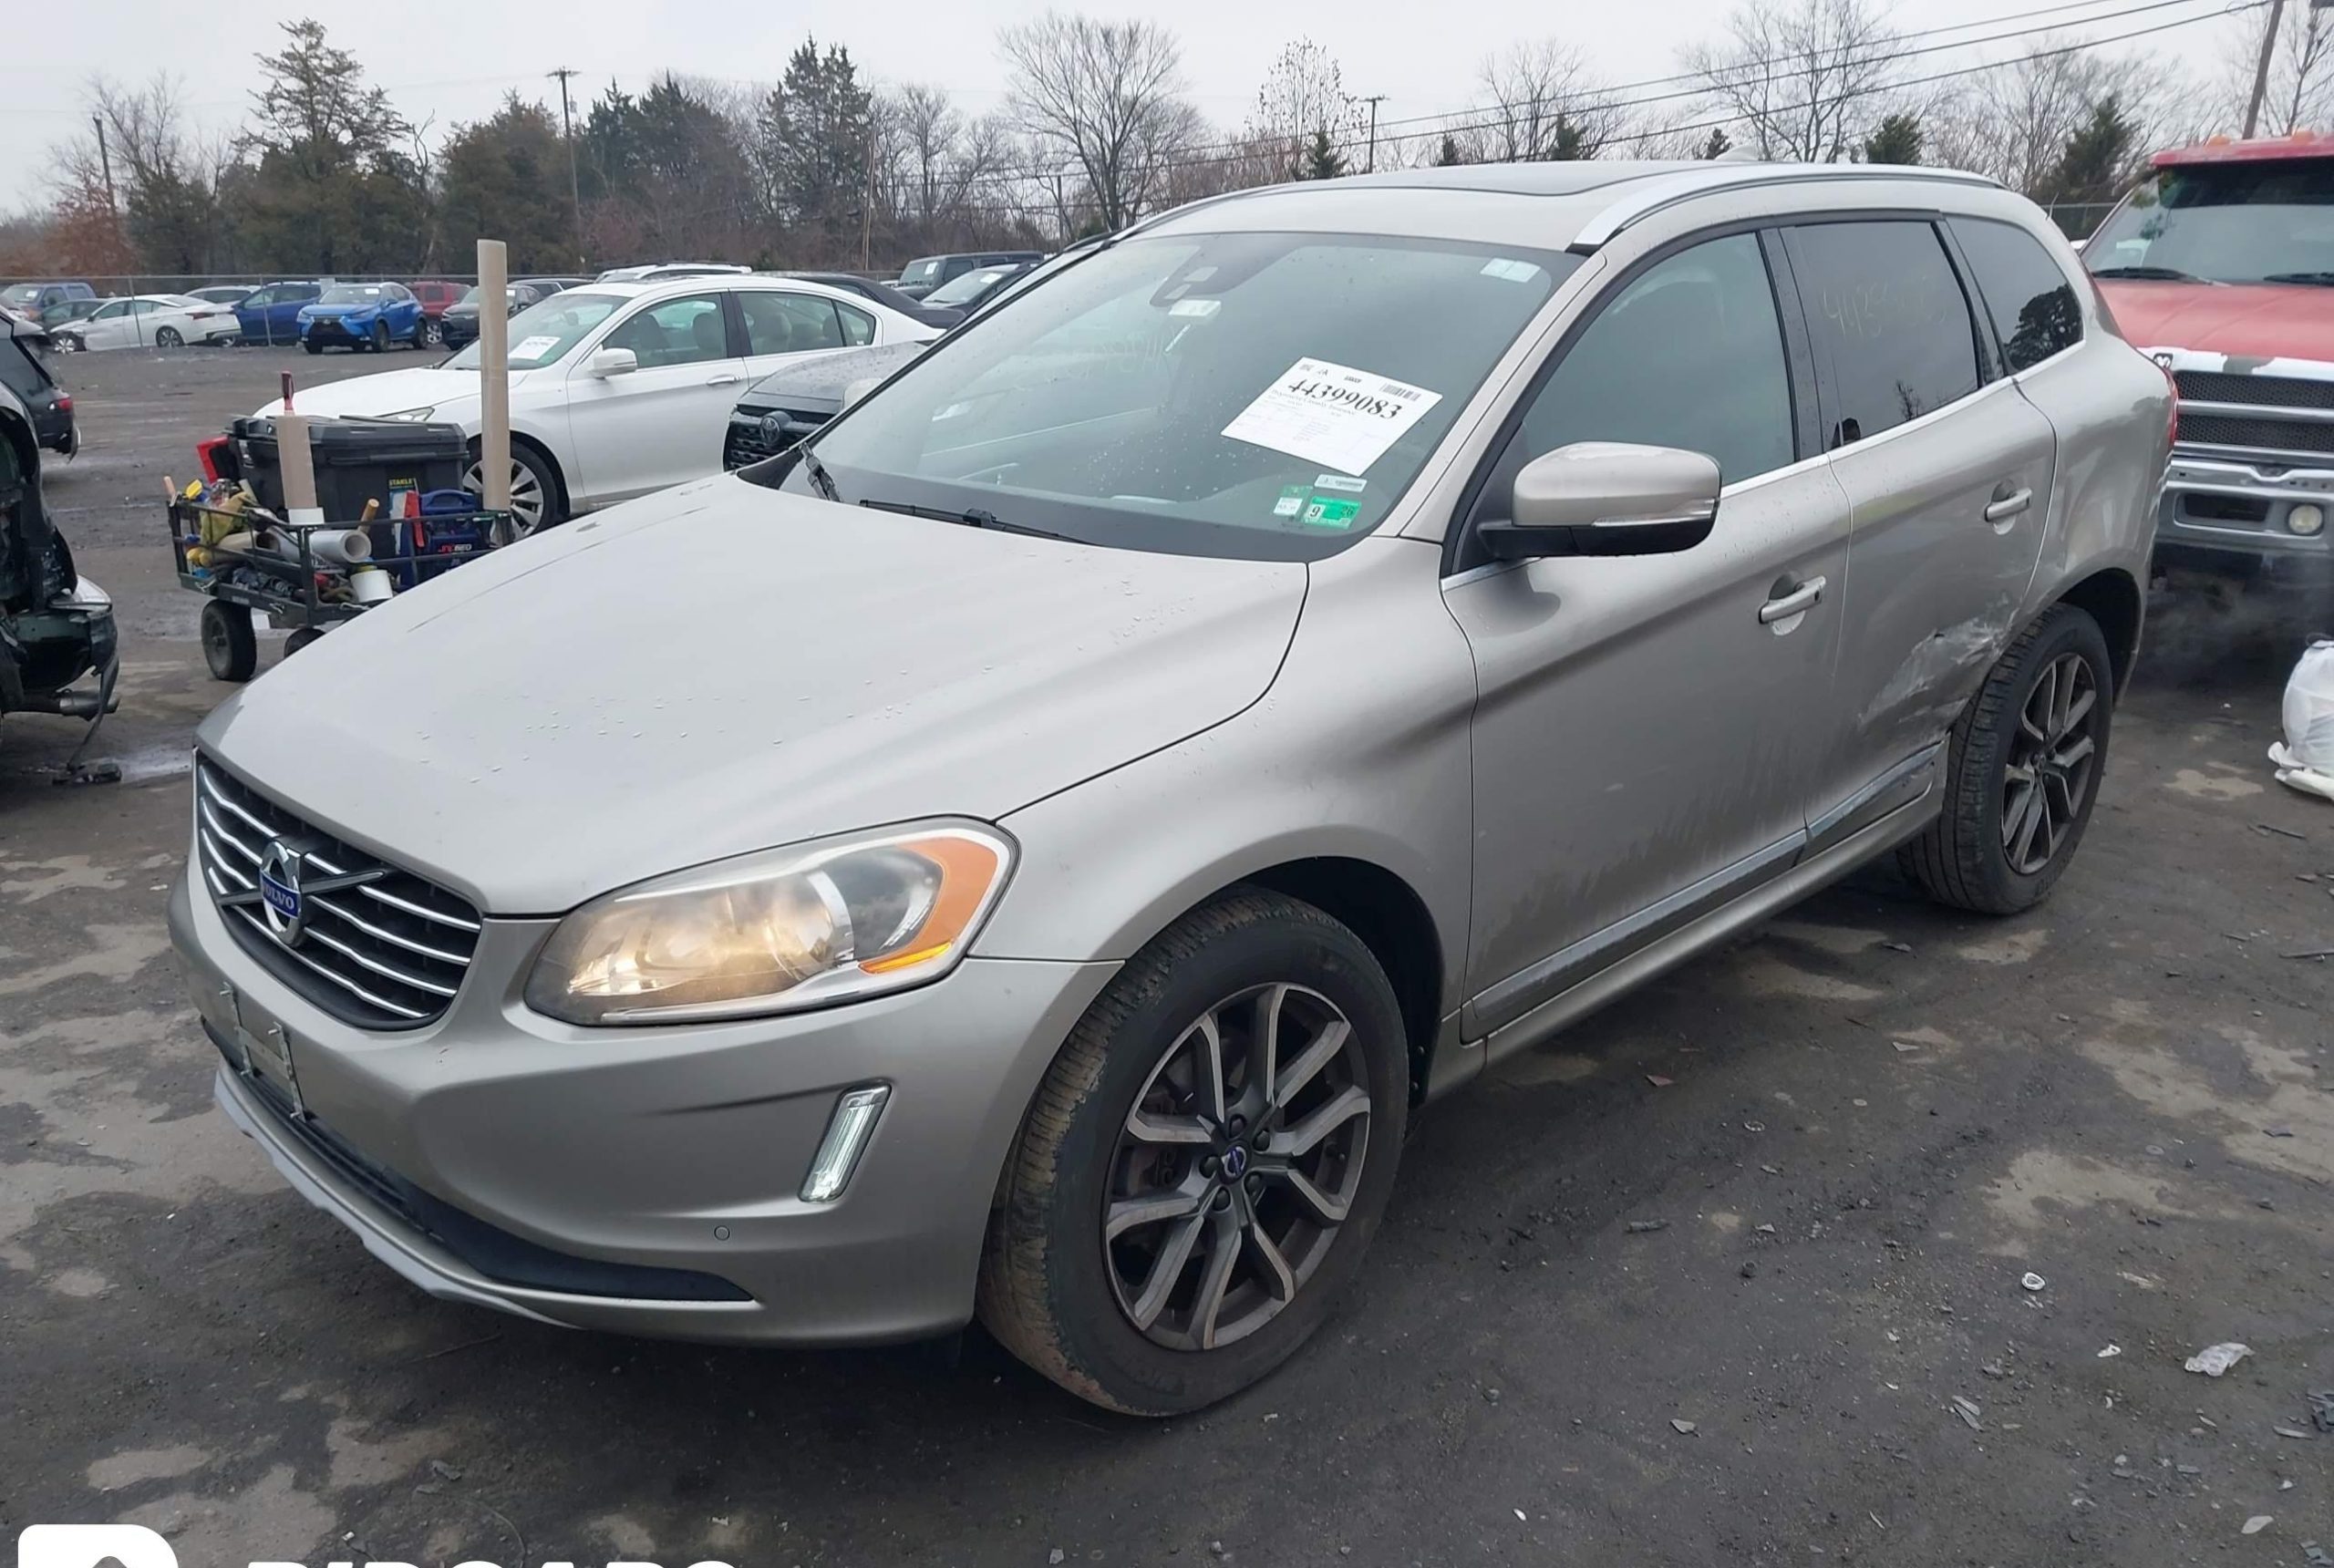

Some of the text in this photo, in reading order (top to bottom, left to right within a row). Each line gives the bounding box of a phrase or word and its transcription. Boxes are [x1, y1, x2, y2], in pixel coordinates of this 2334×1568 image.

[1288, 379, 1402, 419] 44399083
[1309, 505, 1321, 517] 9
[262, 882, 294, 910] VOLVO
